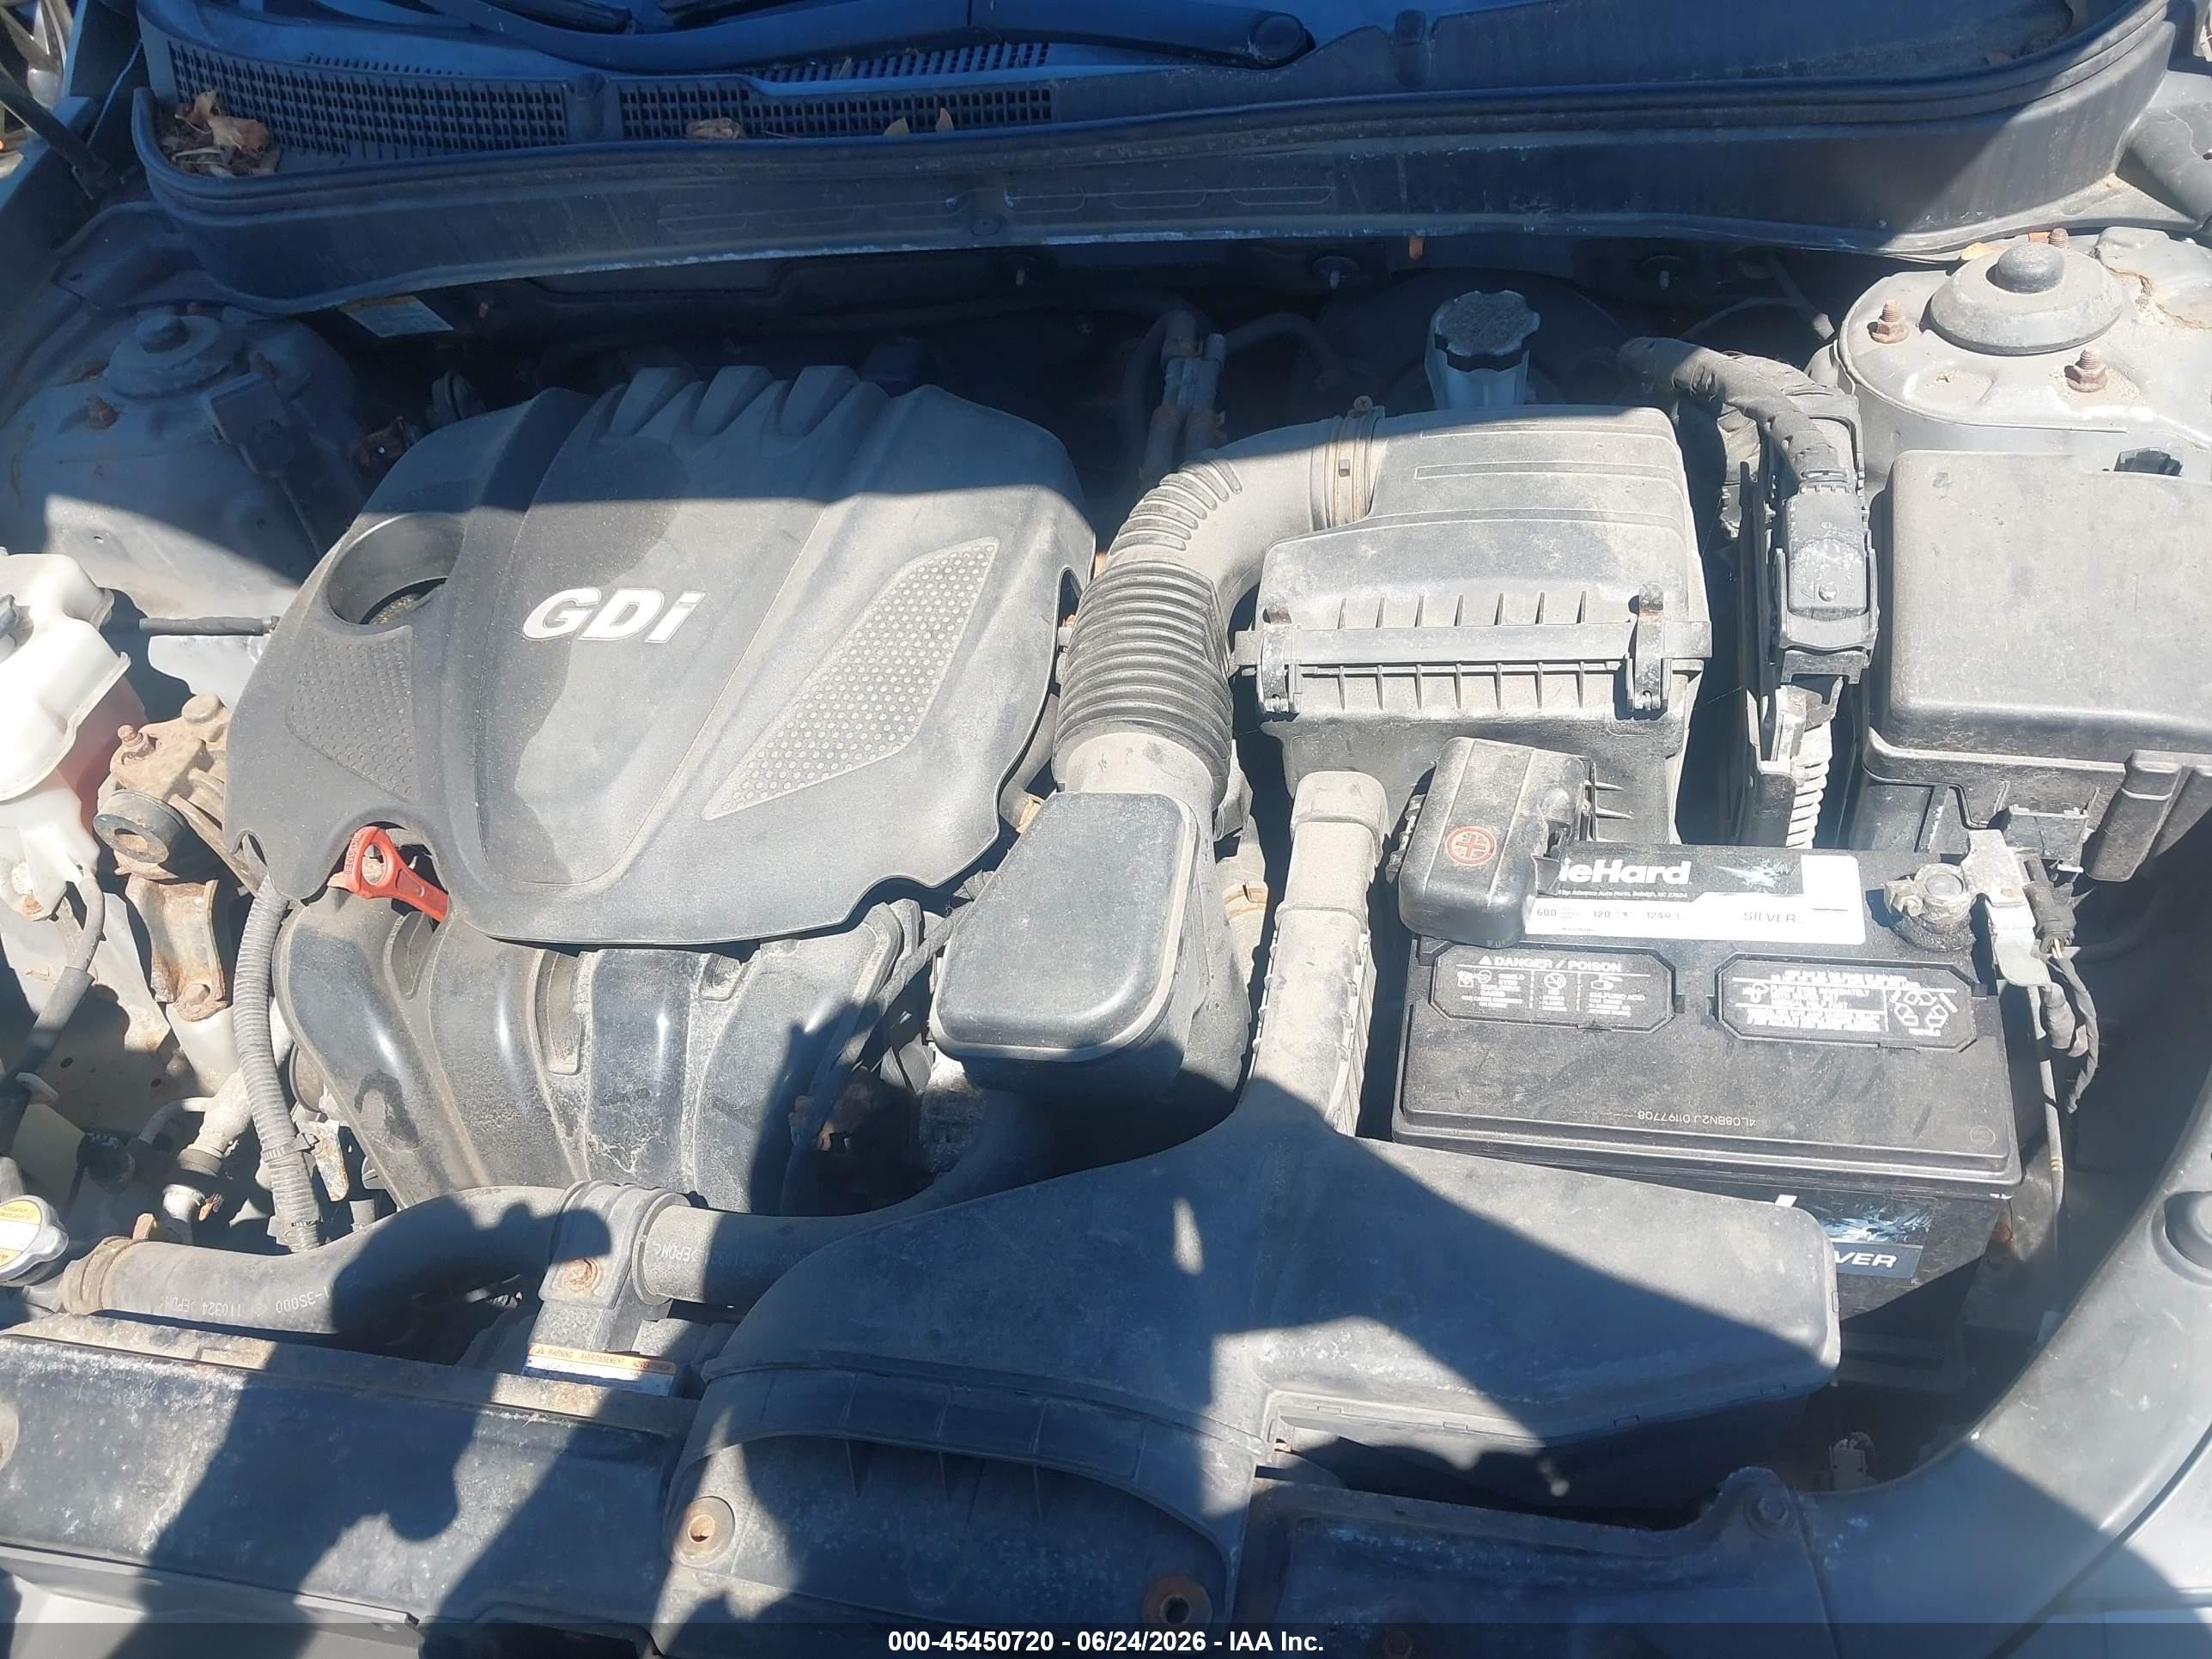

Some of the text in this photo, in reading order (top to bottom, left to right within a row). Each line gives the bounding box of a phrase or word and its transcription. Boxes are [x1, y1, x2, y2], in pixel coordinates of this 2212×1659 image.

[522, 586, 707, 643] GDi
[1559, 857, 1692, 885] ieHard
[1536, 908, 1557, 917] 600
[1593, 910, 1611, 919] 120
[1743, 911, 1797, 924] SILVER
[1494, 956, 1553, 969] DANGER
[1567, 960, 1622, 973] POISON
[1638, 1110, 1757, 1127] 4L08BN2J 01197708
[1834, 1250, 1897, 1268] VER
[547, 1348, 574, 1358] WARNING
